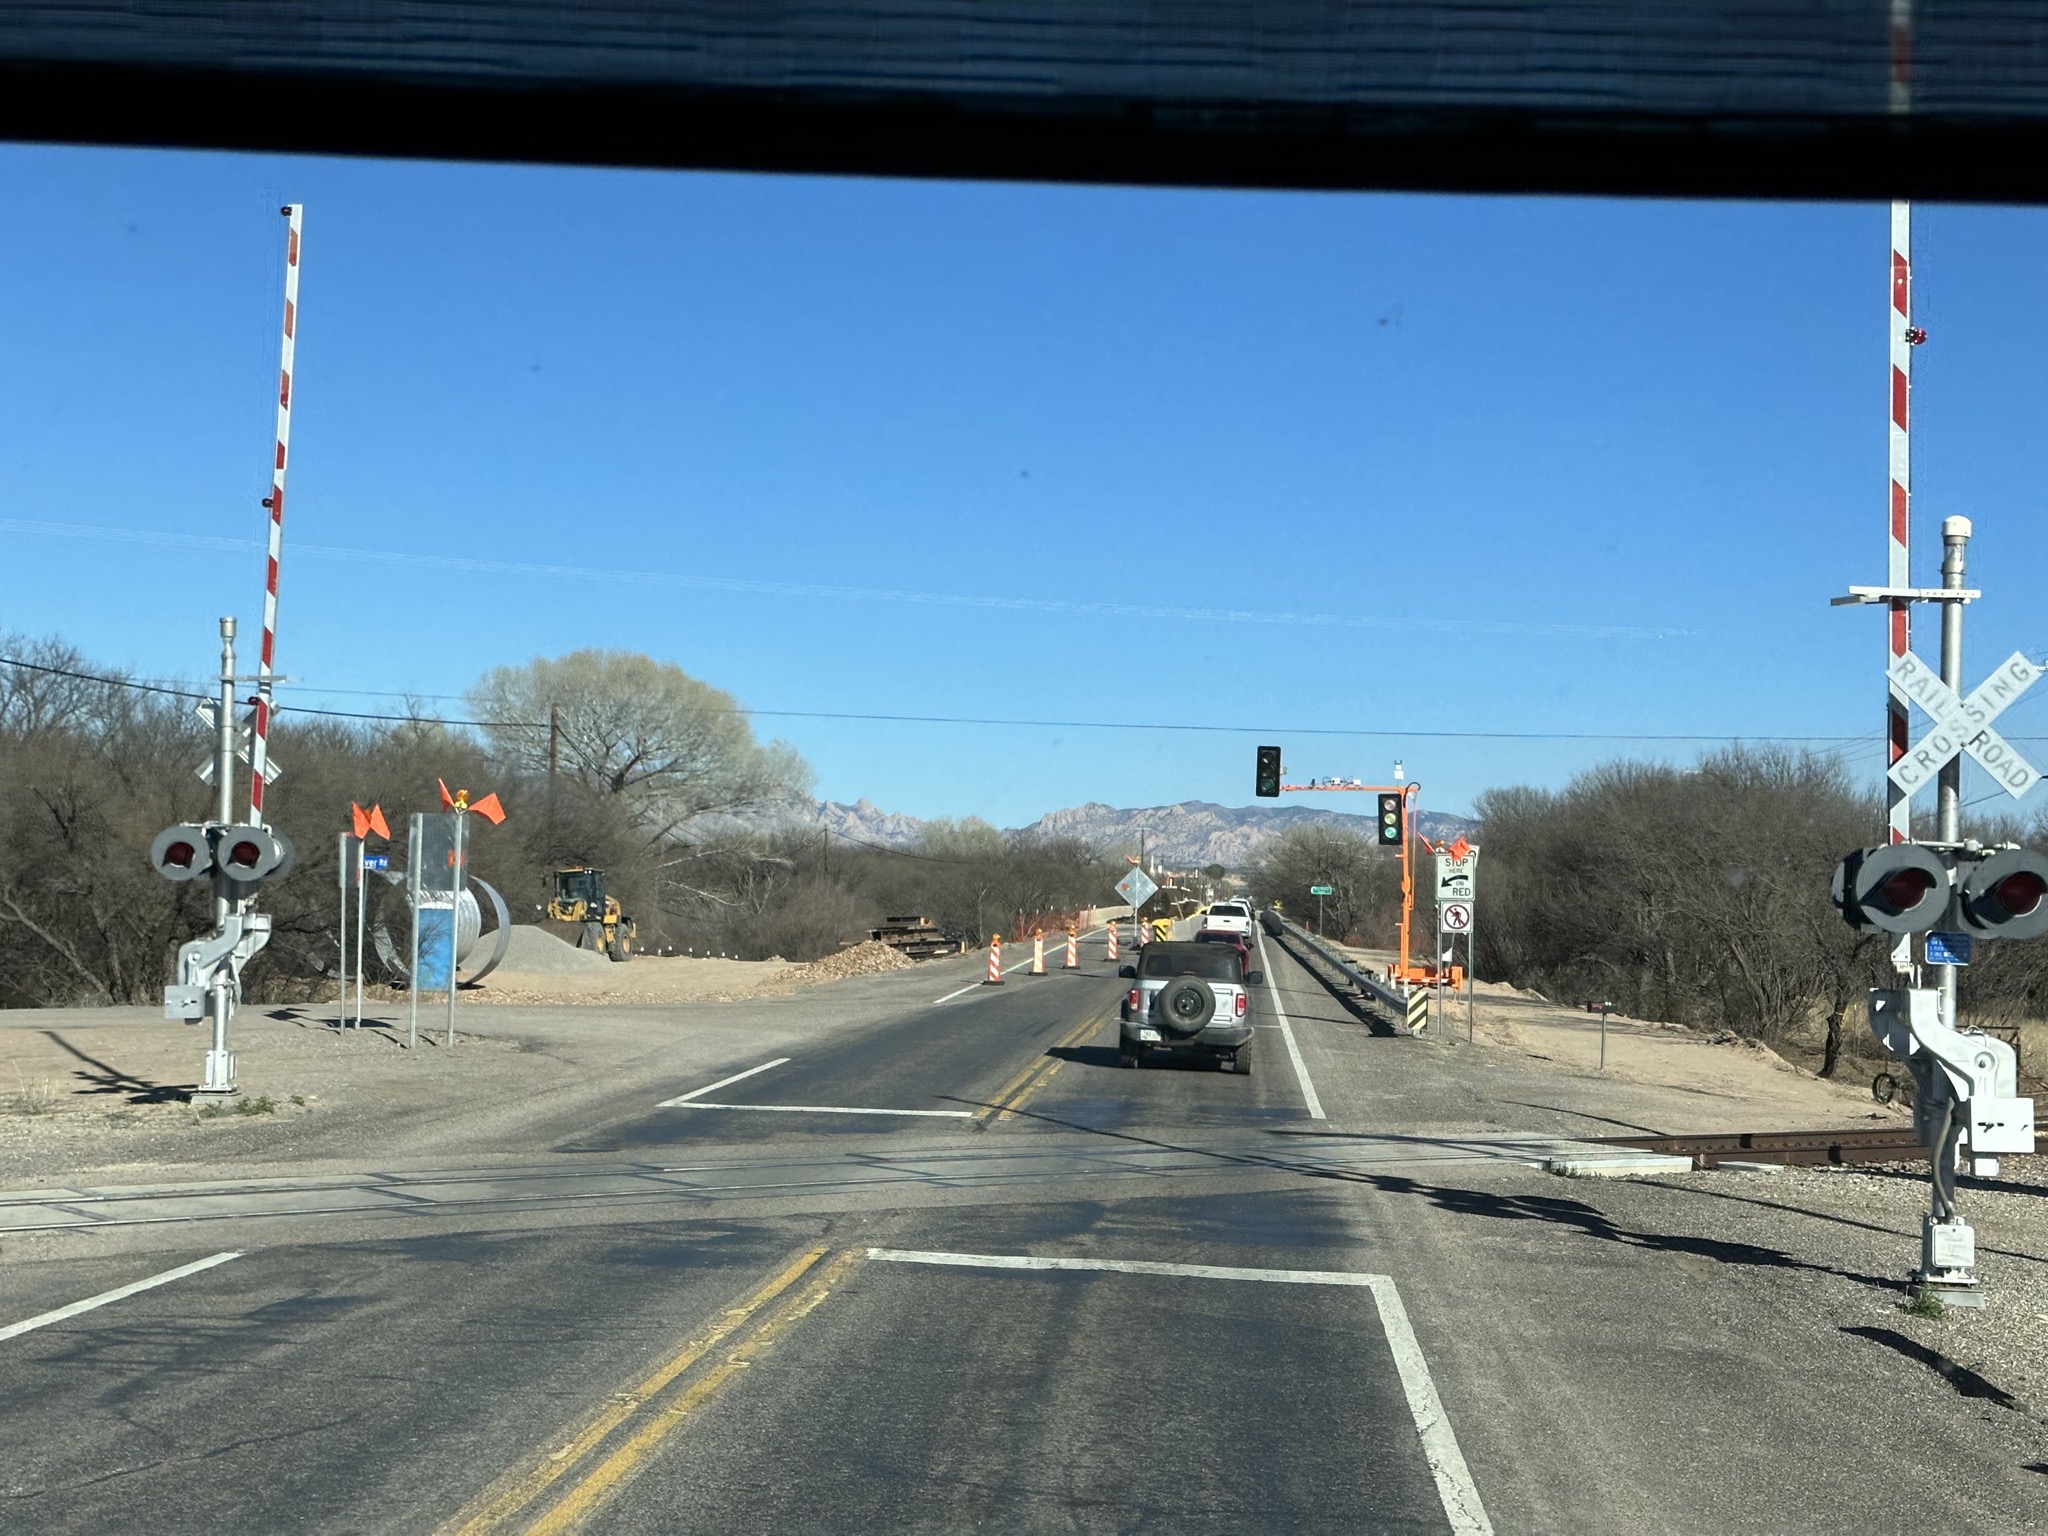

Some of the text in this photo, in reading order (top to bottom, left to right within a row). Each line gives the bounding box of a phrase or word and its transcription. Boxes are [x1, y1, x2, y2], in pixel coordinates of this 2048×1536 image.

[1895, 659, 2029, 788] RAIL ROAD
[1898, 662, 2029, 785] CROSSING
[364, 859, 378, 867] ver
[1445, 858, 1468, 867] STOP
[1452, 887, 1471, 896] RED
